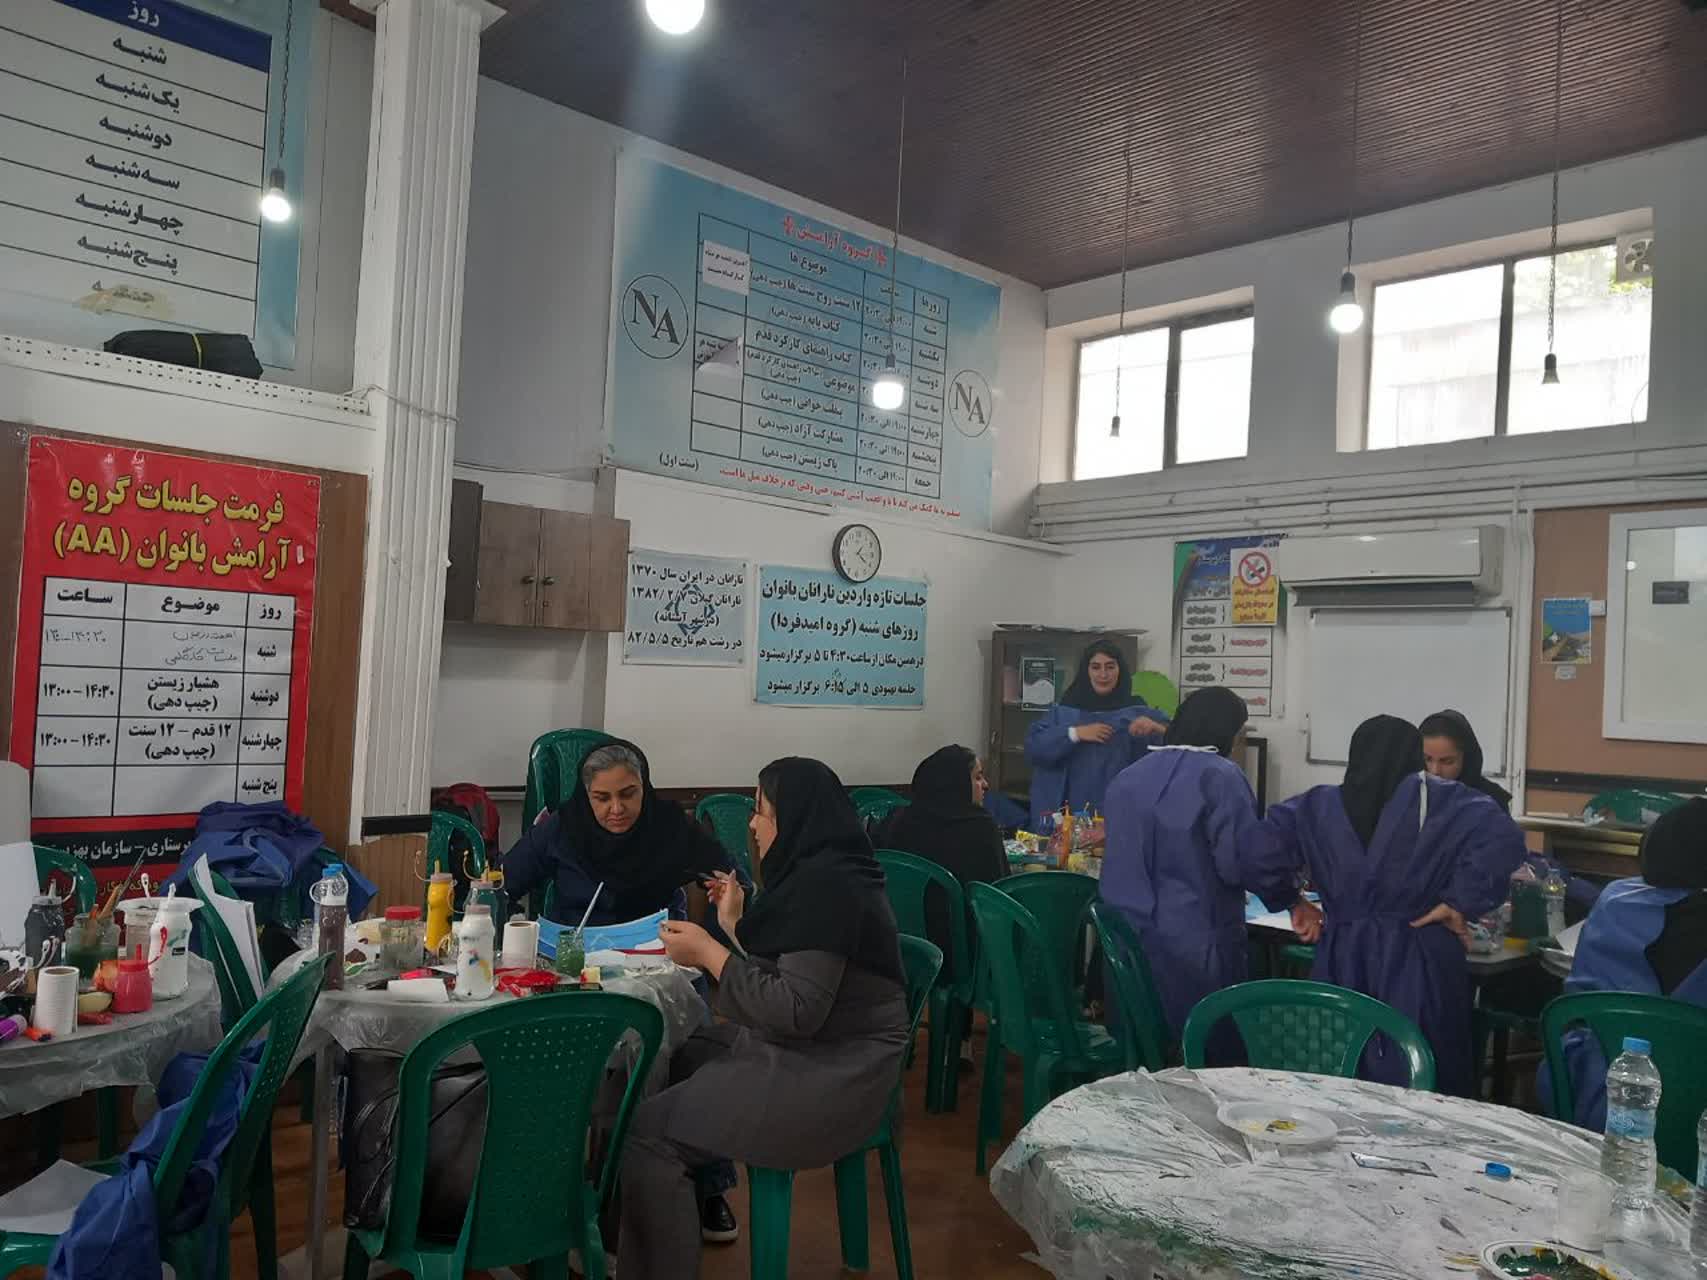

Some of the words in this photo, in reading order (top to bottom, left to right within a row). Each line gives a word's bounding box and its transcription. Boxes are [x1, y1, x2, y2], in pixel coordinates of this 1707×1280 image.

[128, 1, 160, 27] روز
[628, 287, 680, 345] NA
[953, 381, 985, 425] NA
[67, 475, 132, 515] گروه
[136, 479, 218, 525] جلسات
[223, 492, 285, 533] فرمت
[53, 520, 131, 564] (AA)
[136, 527, 207, 572] بانوان
[211, 536, 292, 580] آرامش
[660, 568, 677, 580] سال
[679, 570, 702, 584] ایران
[704, 574, 714, 585] در
[57, 587, 113, 604] ساعت
[762, 579, 797, 600] بانوان
[836, 588, 872, 607] واردین
[873, 589, 892, 608] تازه
[161, 596, 220, 615] موضوع
[893, 591, 926, 611] جلسات
[259, 603, 282, 621] روز
[859, 620, 880, 637] شنبه
[882, 621, 918, 641] روزهای
[257, 645, 277, 662] شنبه
[147, 676, 185, 692] زیستن
[187, 676, 220, 692] هشیار
[250, 689, 279, 706] دوشنبه
[128, 723, 156, 737] سنت
[192, 723, 215, 741] قدم
[241, 733, 282, 751] چهارشنبه
[91, 839, 132, 860] سازمان
